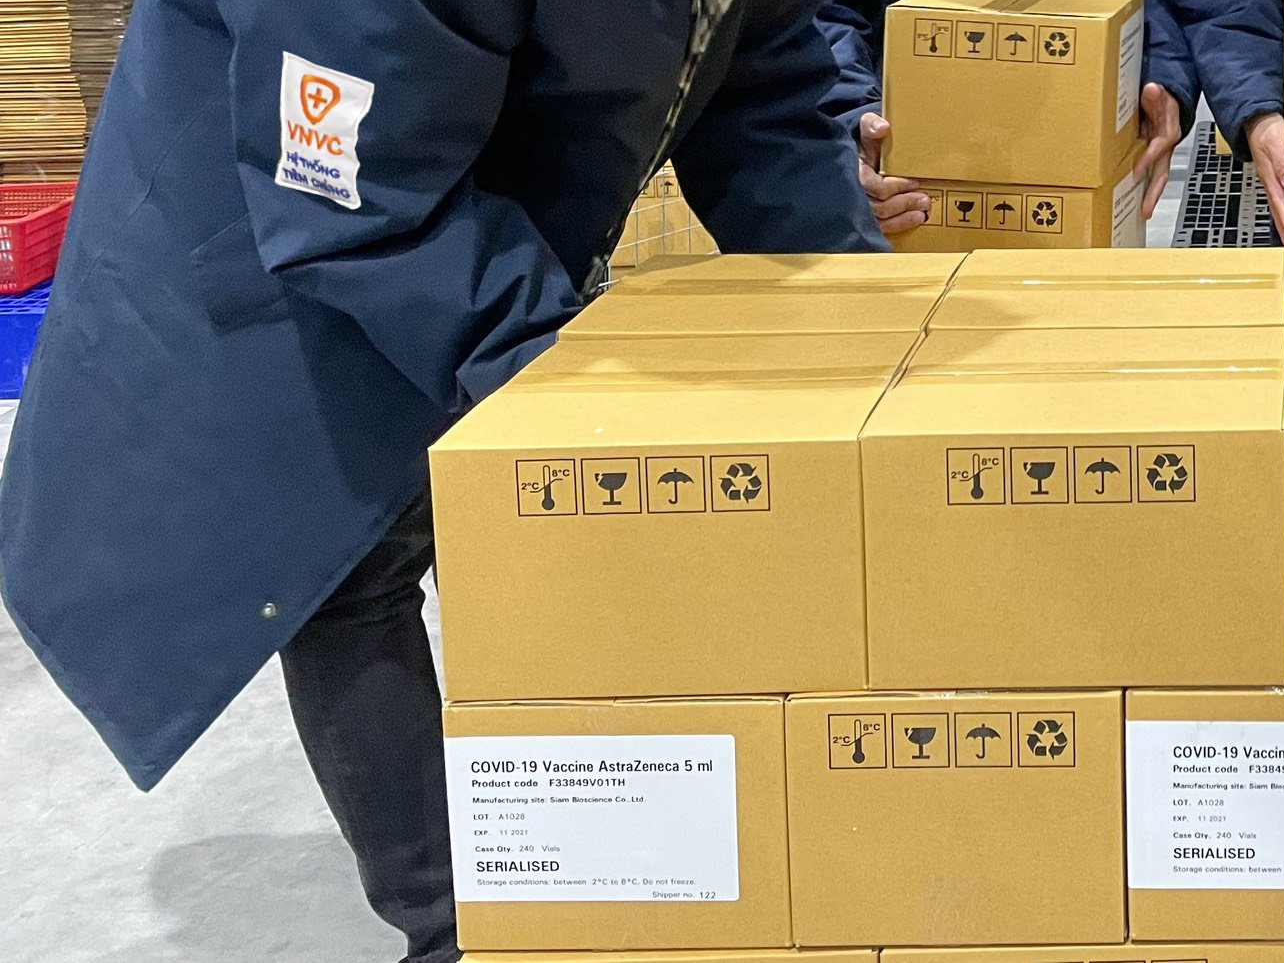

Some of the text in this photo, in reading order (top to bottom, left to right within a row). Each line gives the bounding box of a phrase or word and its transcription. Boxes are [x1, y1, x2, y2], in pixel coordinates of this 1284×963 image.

[287, 120, 344, 155] VNVC
[1173, 746, 1238, 758] COVID-19
[471, 760, 712, 773] COVID-19 Vaccine AstraZeneca 5 ml
[1173, 765, 1210, 773] Product
[1215, 765, 1238, 773] code
[514, 779, 538, 787] code
[549, 779, 625, 787] F33849V01TH
[1174, 848, 1255, 859] SERIALISED
[477, 861, 559, 872] SERIALISED
[652, 891, 681, 899] Shipper
